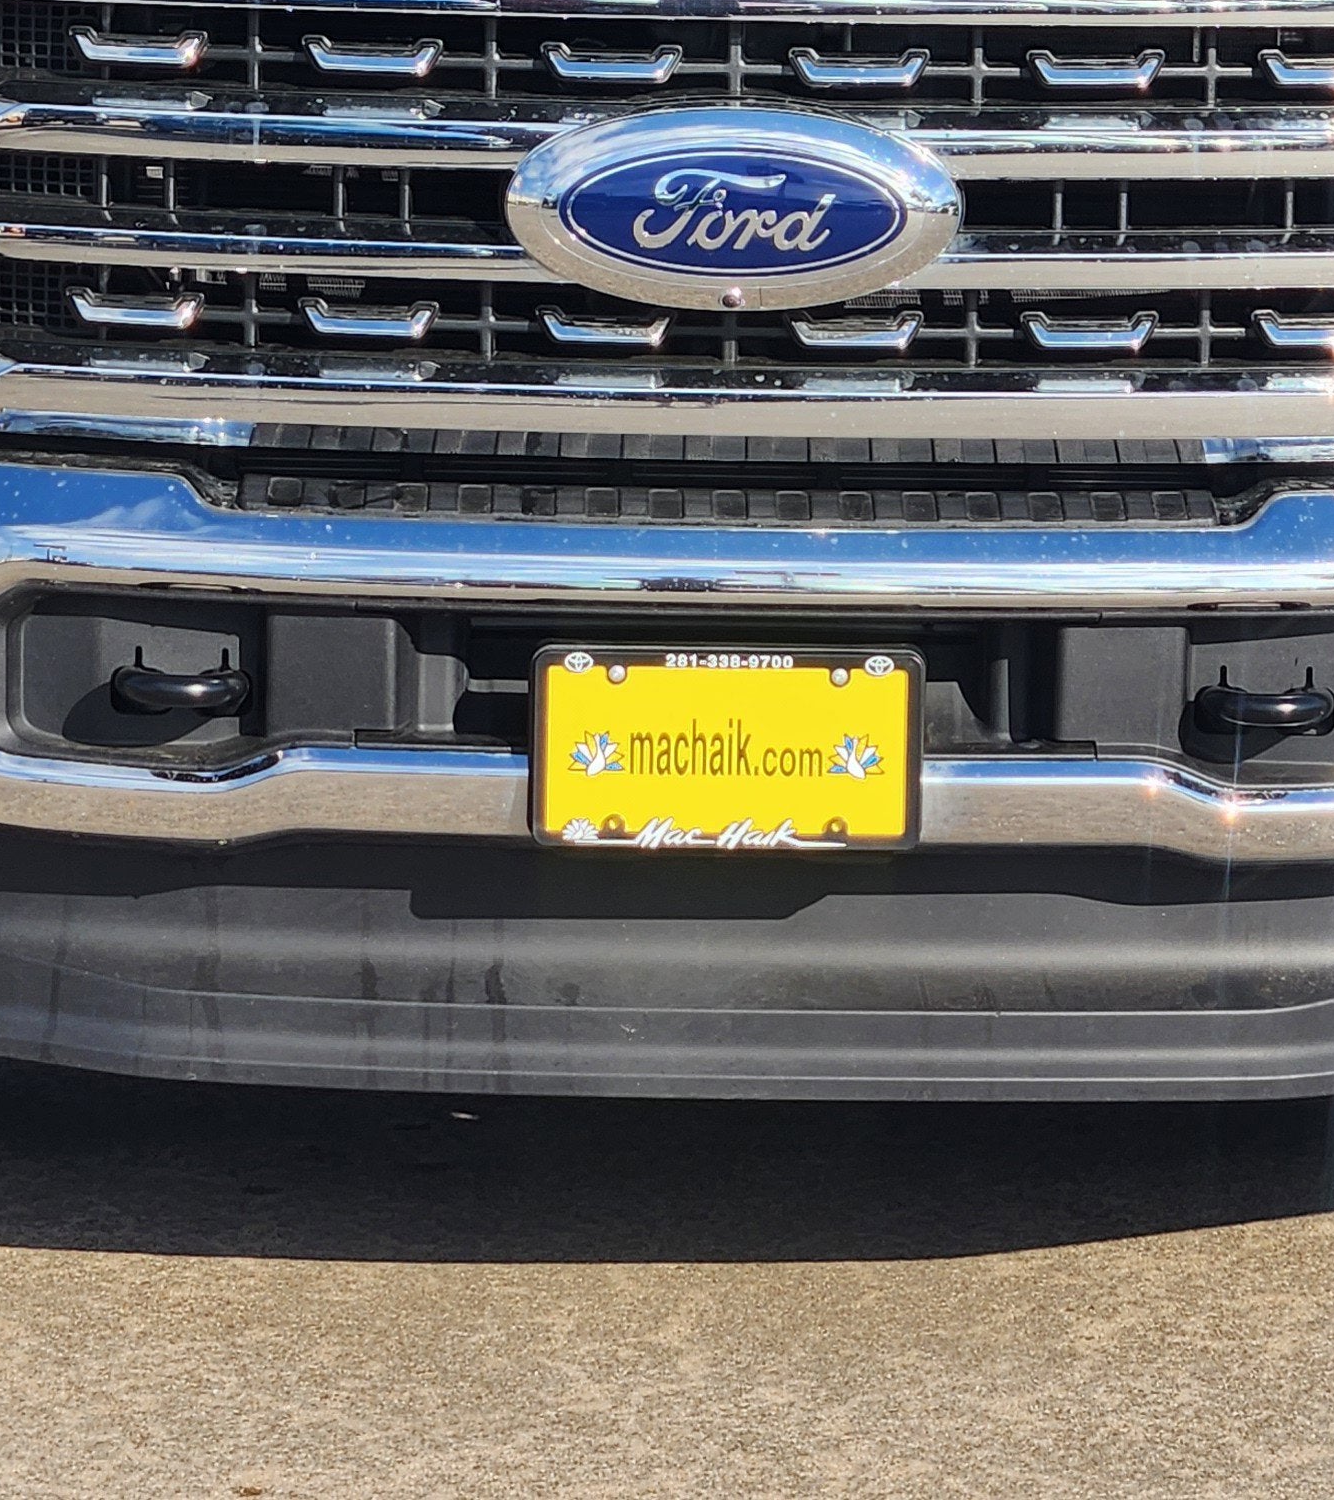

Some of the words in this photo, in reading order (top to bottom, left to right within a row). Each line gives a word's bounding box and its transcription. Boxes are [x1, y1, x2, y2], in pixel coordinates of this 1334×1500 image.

[632, 167, 836, 251] Ford
[665, 653, 794, 669] 281-338-9700
[629, 718, 823, 777] machaik.com
[634, 816, 712, 849] Mac
[716, 816, 800, 849] Haik
